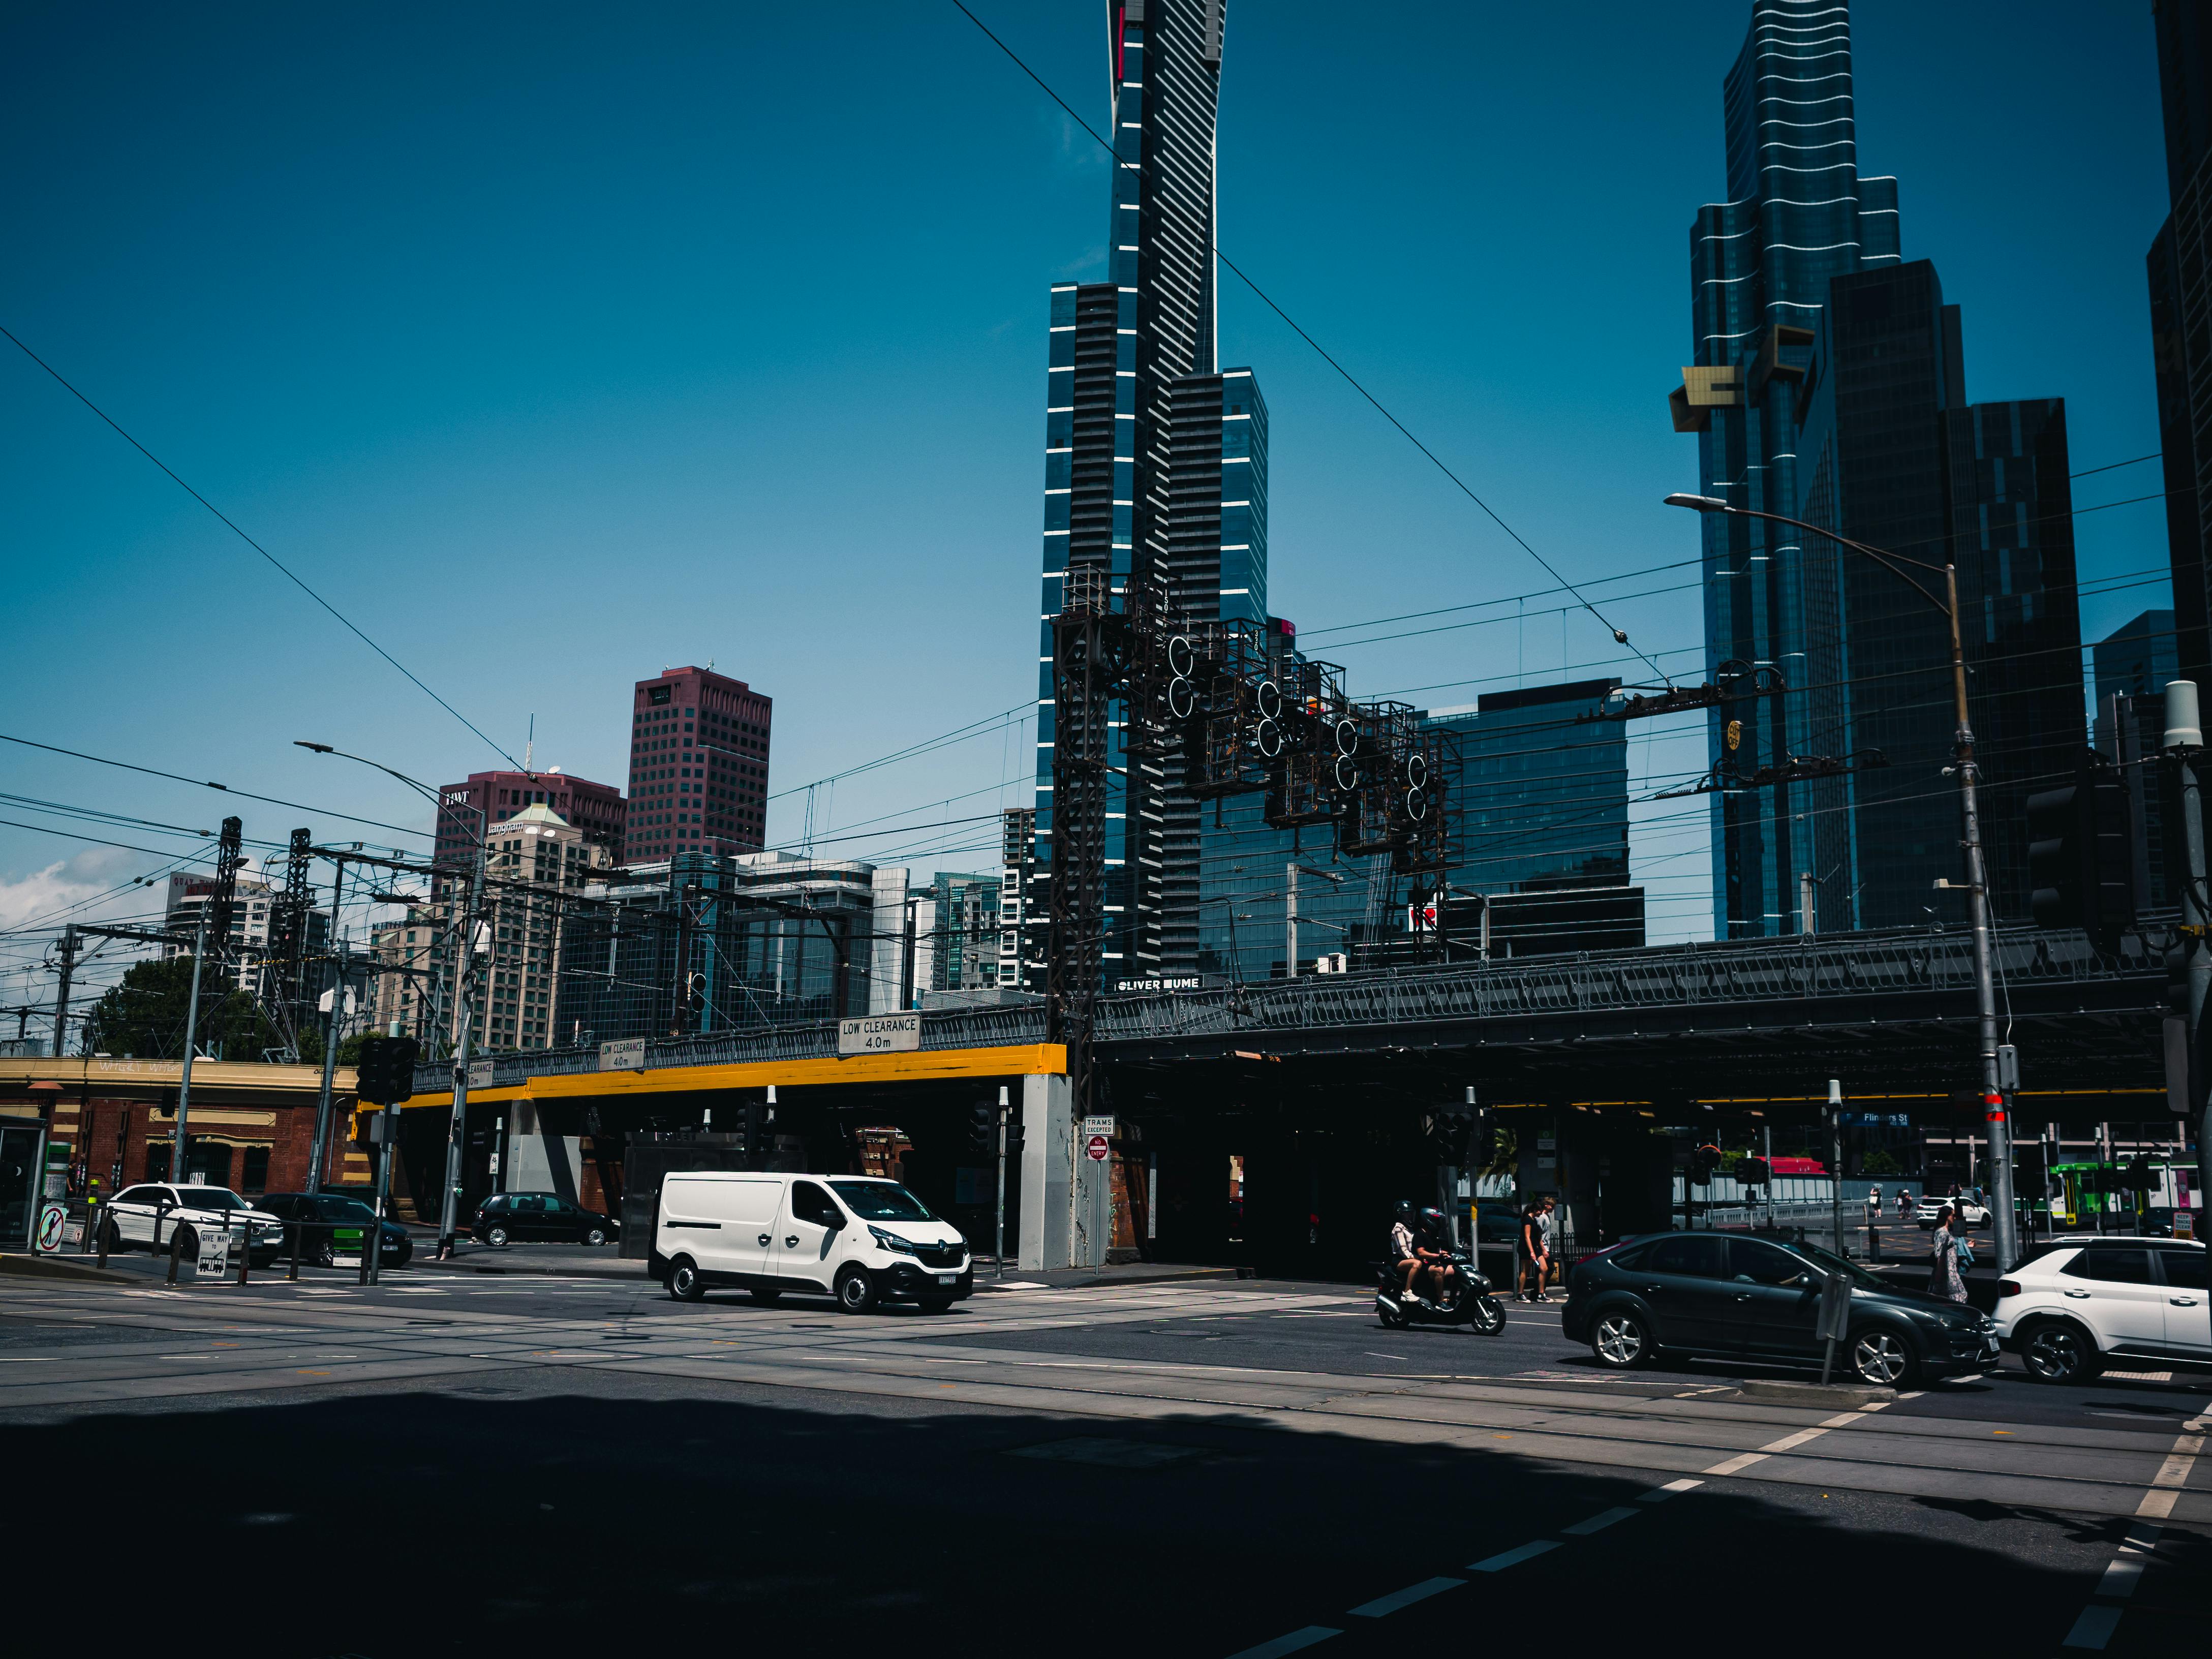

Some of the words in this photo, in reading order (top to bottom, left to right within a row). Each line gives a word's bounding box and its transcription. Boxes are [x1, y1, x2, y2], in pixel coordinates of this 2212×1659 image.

[1729, 725, 1739, 736] CUT
[1729, 736, 1738, 746] OFF
[488, 821, 524, 835] Langham
[1118, 980, 1160, 991] OLIVER
[843, 1023, 860, 1035] LOW
[864, 1019, 916, 1033] CLEARANCE
[866, 1036, 890, 1048] 4.0m
[602, 1045, 612, 1055] LOW
[613, 1041, 643, 1054] CLEARANCE
[613, 1057, 628, 1066] 4.0m
[1864, 1113, 1896, 1121] Flinders
[1898, 1114, 1908, 1122] St
[202, 1234, 214, 1243] GIVE
[217, 1235, 228, 1243] WAY
